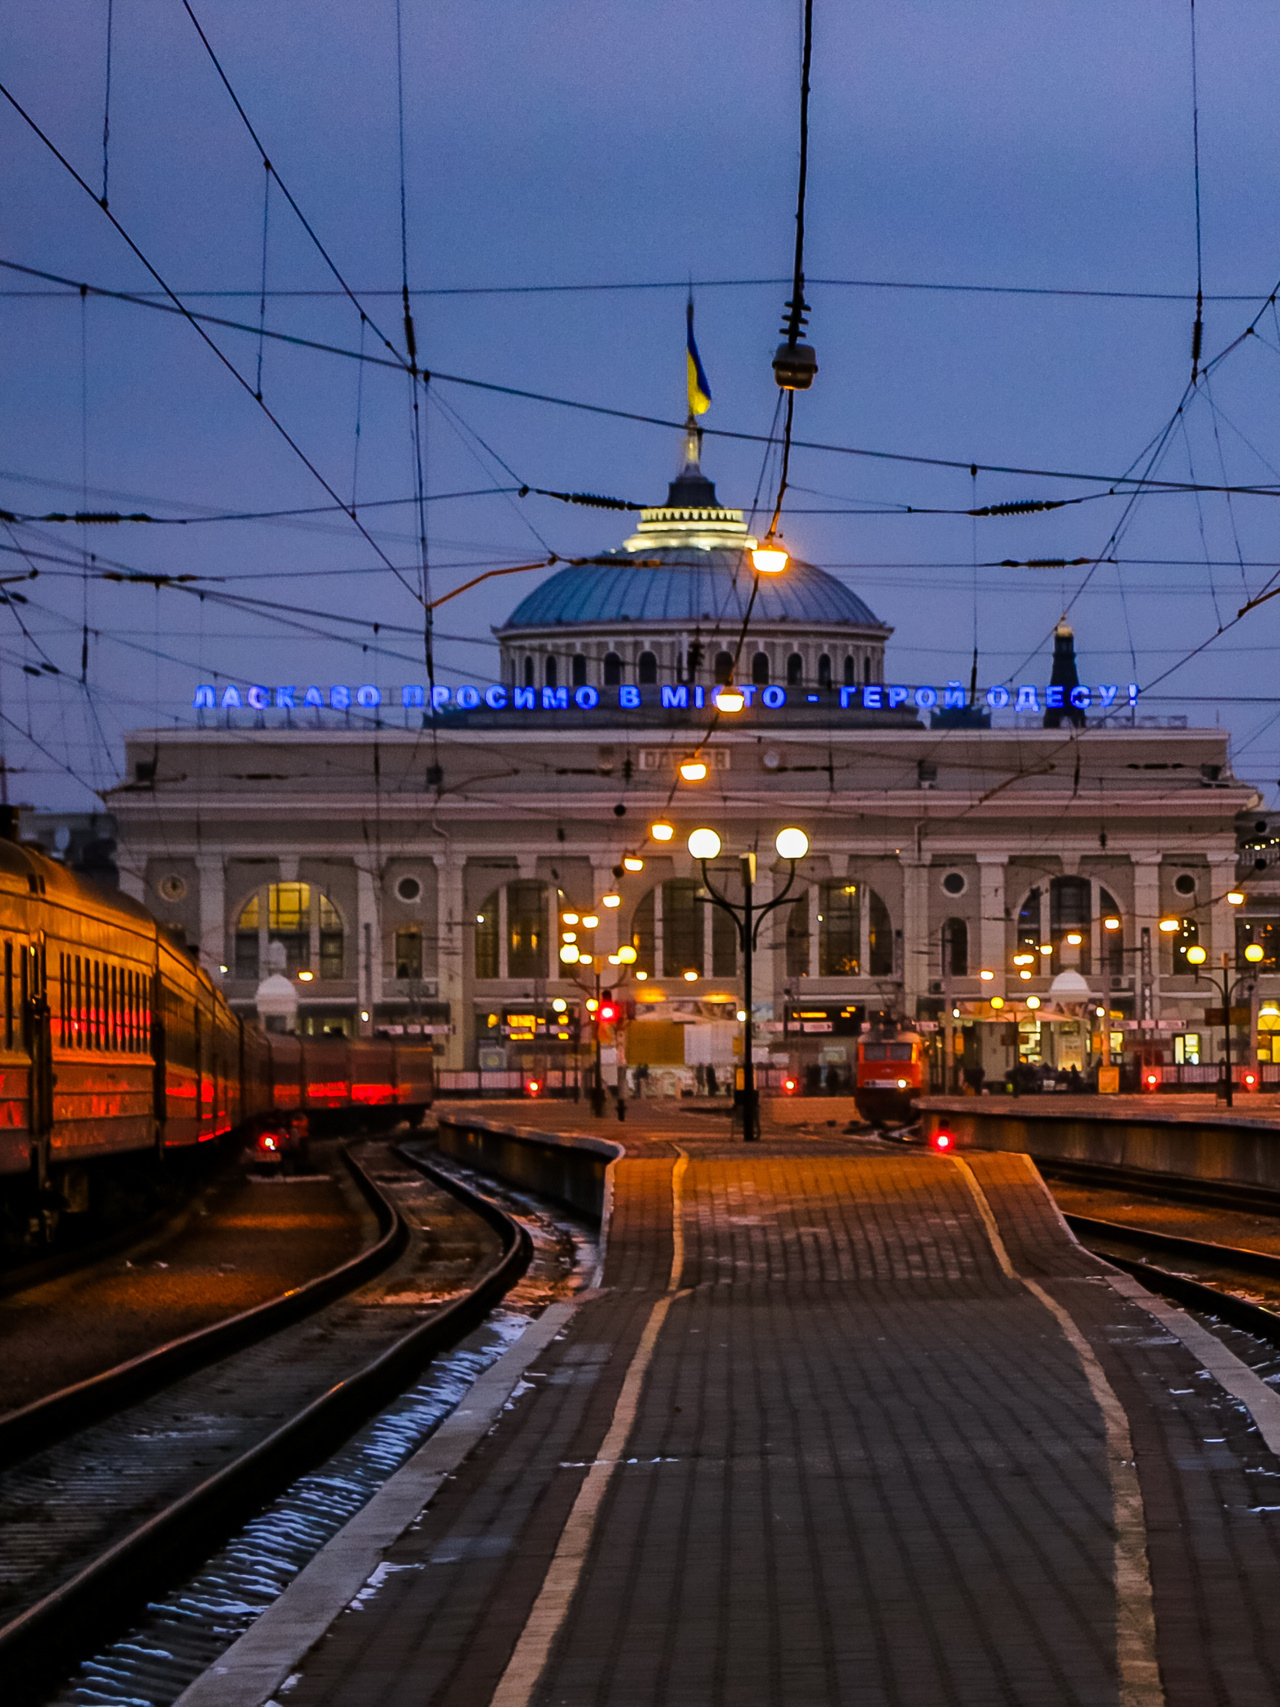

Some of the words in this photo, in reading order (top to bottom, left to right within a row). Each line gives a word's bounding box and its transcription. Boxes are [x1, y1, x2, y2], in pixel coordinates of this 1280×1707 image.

[193, 684, 381, 710] ЛАСКАВО
[402, 684, 600, 710] ПРОСИМО
[619, 684, 641, 709] В
[840, 681, 966, 709] ГЕРОЙ
[986, 683, 1139, 713] ОДЕСУ!
